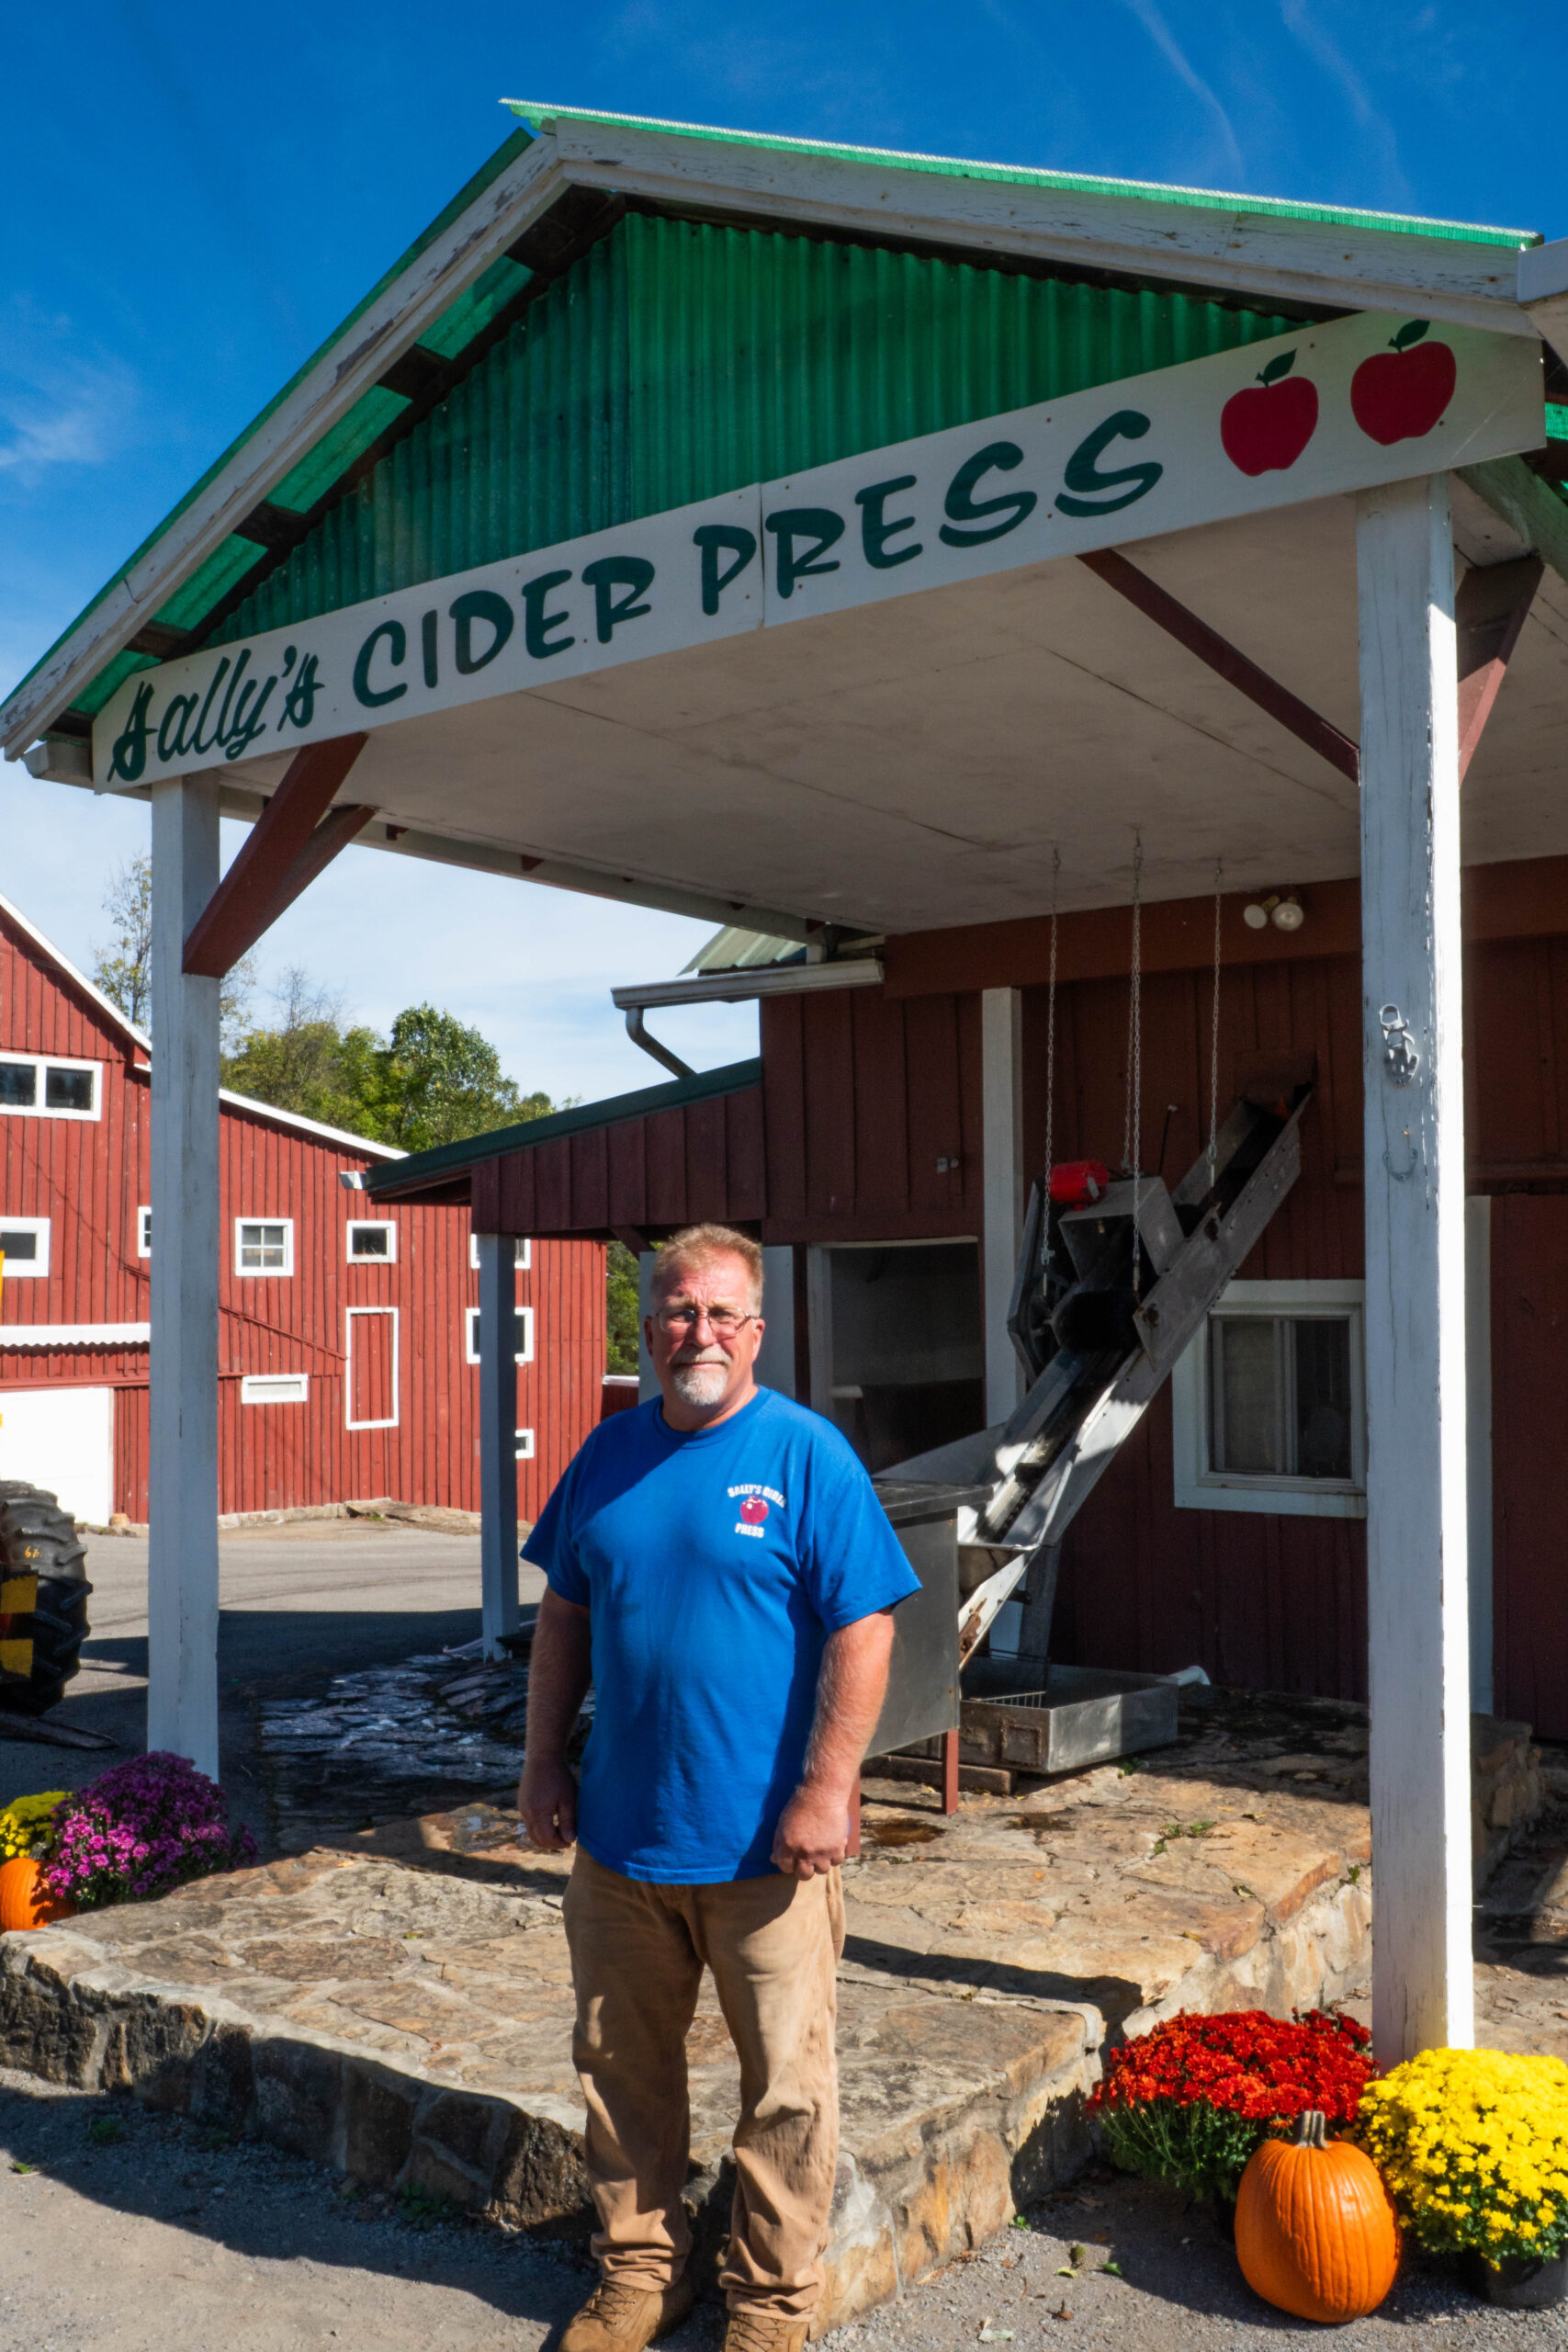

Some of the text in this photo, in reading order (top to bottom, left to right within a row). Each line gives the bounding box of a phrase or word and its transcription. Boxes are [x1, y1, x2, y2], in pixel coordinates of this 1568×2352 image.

[107, 410, 1163, 783] Sally's CIDER PRESS
[728, 1484, 762, 1498] SALLY'S
[735, 1522, 764, 1538] PRESS
